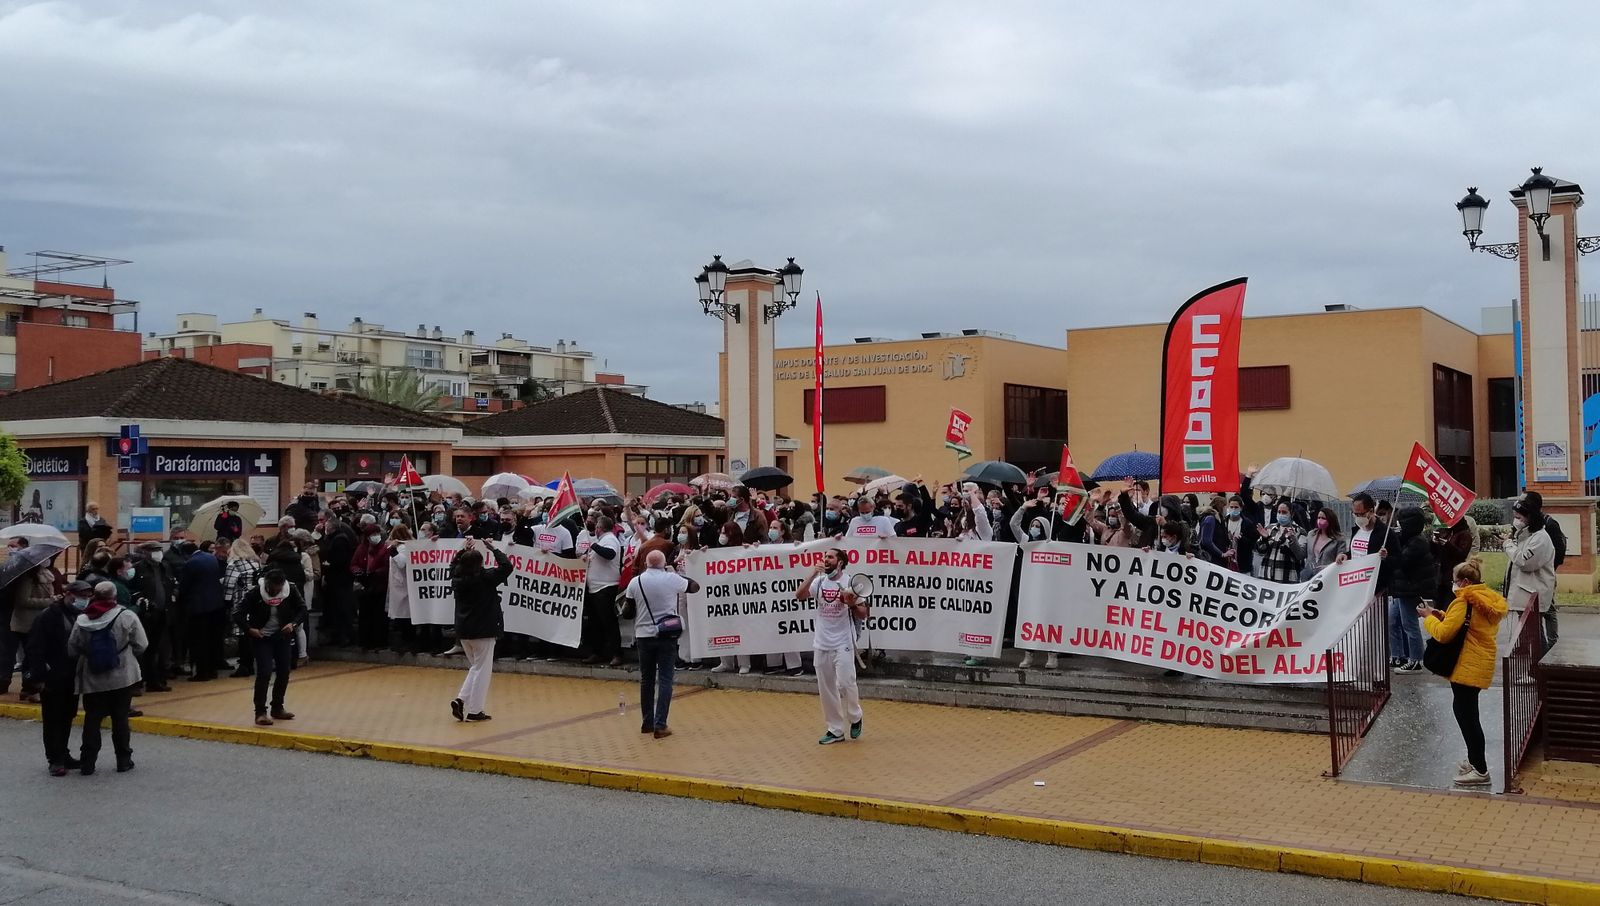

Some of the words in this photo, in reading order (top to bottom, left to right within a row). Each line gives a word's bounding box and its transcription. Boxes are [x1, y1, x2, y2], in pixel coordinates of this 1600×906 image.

[775, 359, 799, 369] MPUS
[841, 357, 846, 365] Y
[848, 355, 860, 365] DE
[861, 350, 928, 364] INVESTIGACIÓN
[799, 371, 810, 380] DE
[824, 368, 851, 378] SALUD
[852, 368, 871, 377] SAN
[872, 366, 896, 376] JUAN
[897, 365, 910, 374] DE
[911, 364, 933, 373] DIOS
[26, 456, 70, 474] Dietética
[156, 454, 241, 472] Parafarmacia
[1183, 475, 1217, 484] Sevilla
[1429, 491, 1456, 519] Sevilla
[525, 558, 587, 583] ALJARAFE
[706, 555, 784, 576] HOSPITAL
[866, 549, 899, 565] DEL
[905, 550, 993, 570] ALJARAFE
[1032, 553, 1061, 564] CCOO
[1086, 552, 1121, 573] NO
[1128, 557, 1143, 576] A
[1150, 559, 1199, 586] LOS
[515, 575, 583, 602] TRABAJAR
[706, 585, 730, 599] POR
[734, 581, 767, 596] UNAS
[878, 574, 942, 590] TRABAJO
[946, 577, 993, 594] DIGNAS
[508, 592, 578, 620] DERECHOS
[707, 603, 739, 618] PARA
[742, 601, 767, 615] UNA
[918, 596, 936, 609] DE
[940, 597, 993, 615] CALIDAD
[1090, 577, 1107, 597] Y
[1114, 581, 1129, 600] A
[1136, 583, 1182, 609] LOS
[1189, 592, 1319, 629] RECORTES
[1106, 605, 1135, 627] EN
[1140, 609, 1168, 633] EL
[1177, 616, 1302, 649] HOSPITAL
[1020, 622, 1063, 644] SAN
[1069, 627, 1126, 652] JUAN
[1131, 634, 1154, 657] DE
[1160, 639, 1214, 670] DIOS
[1220, 653, 1265, 675] DEL
